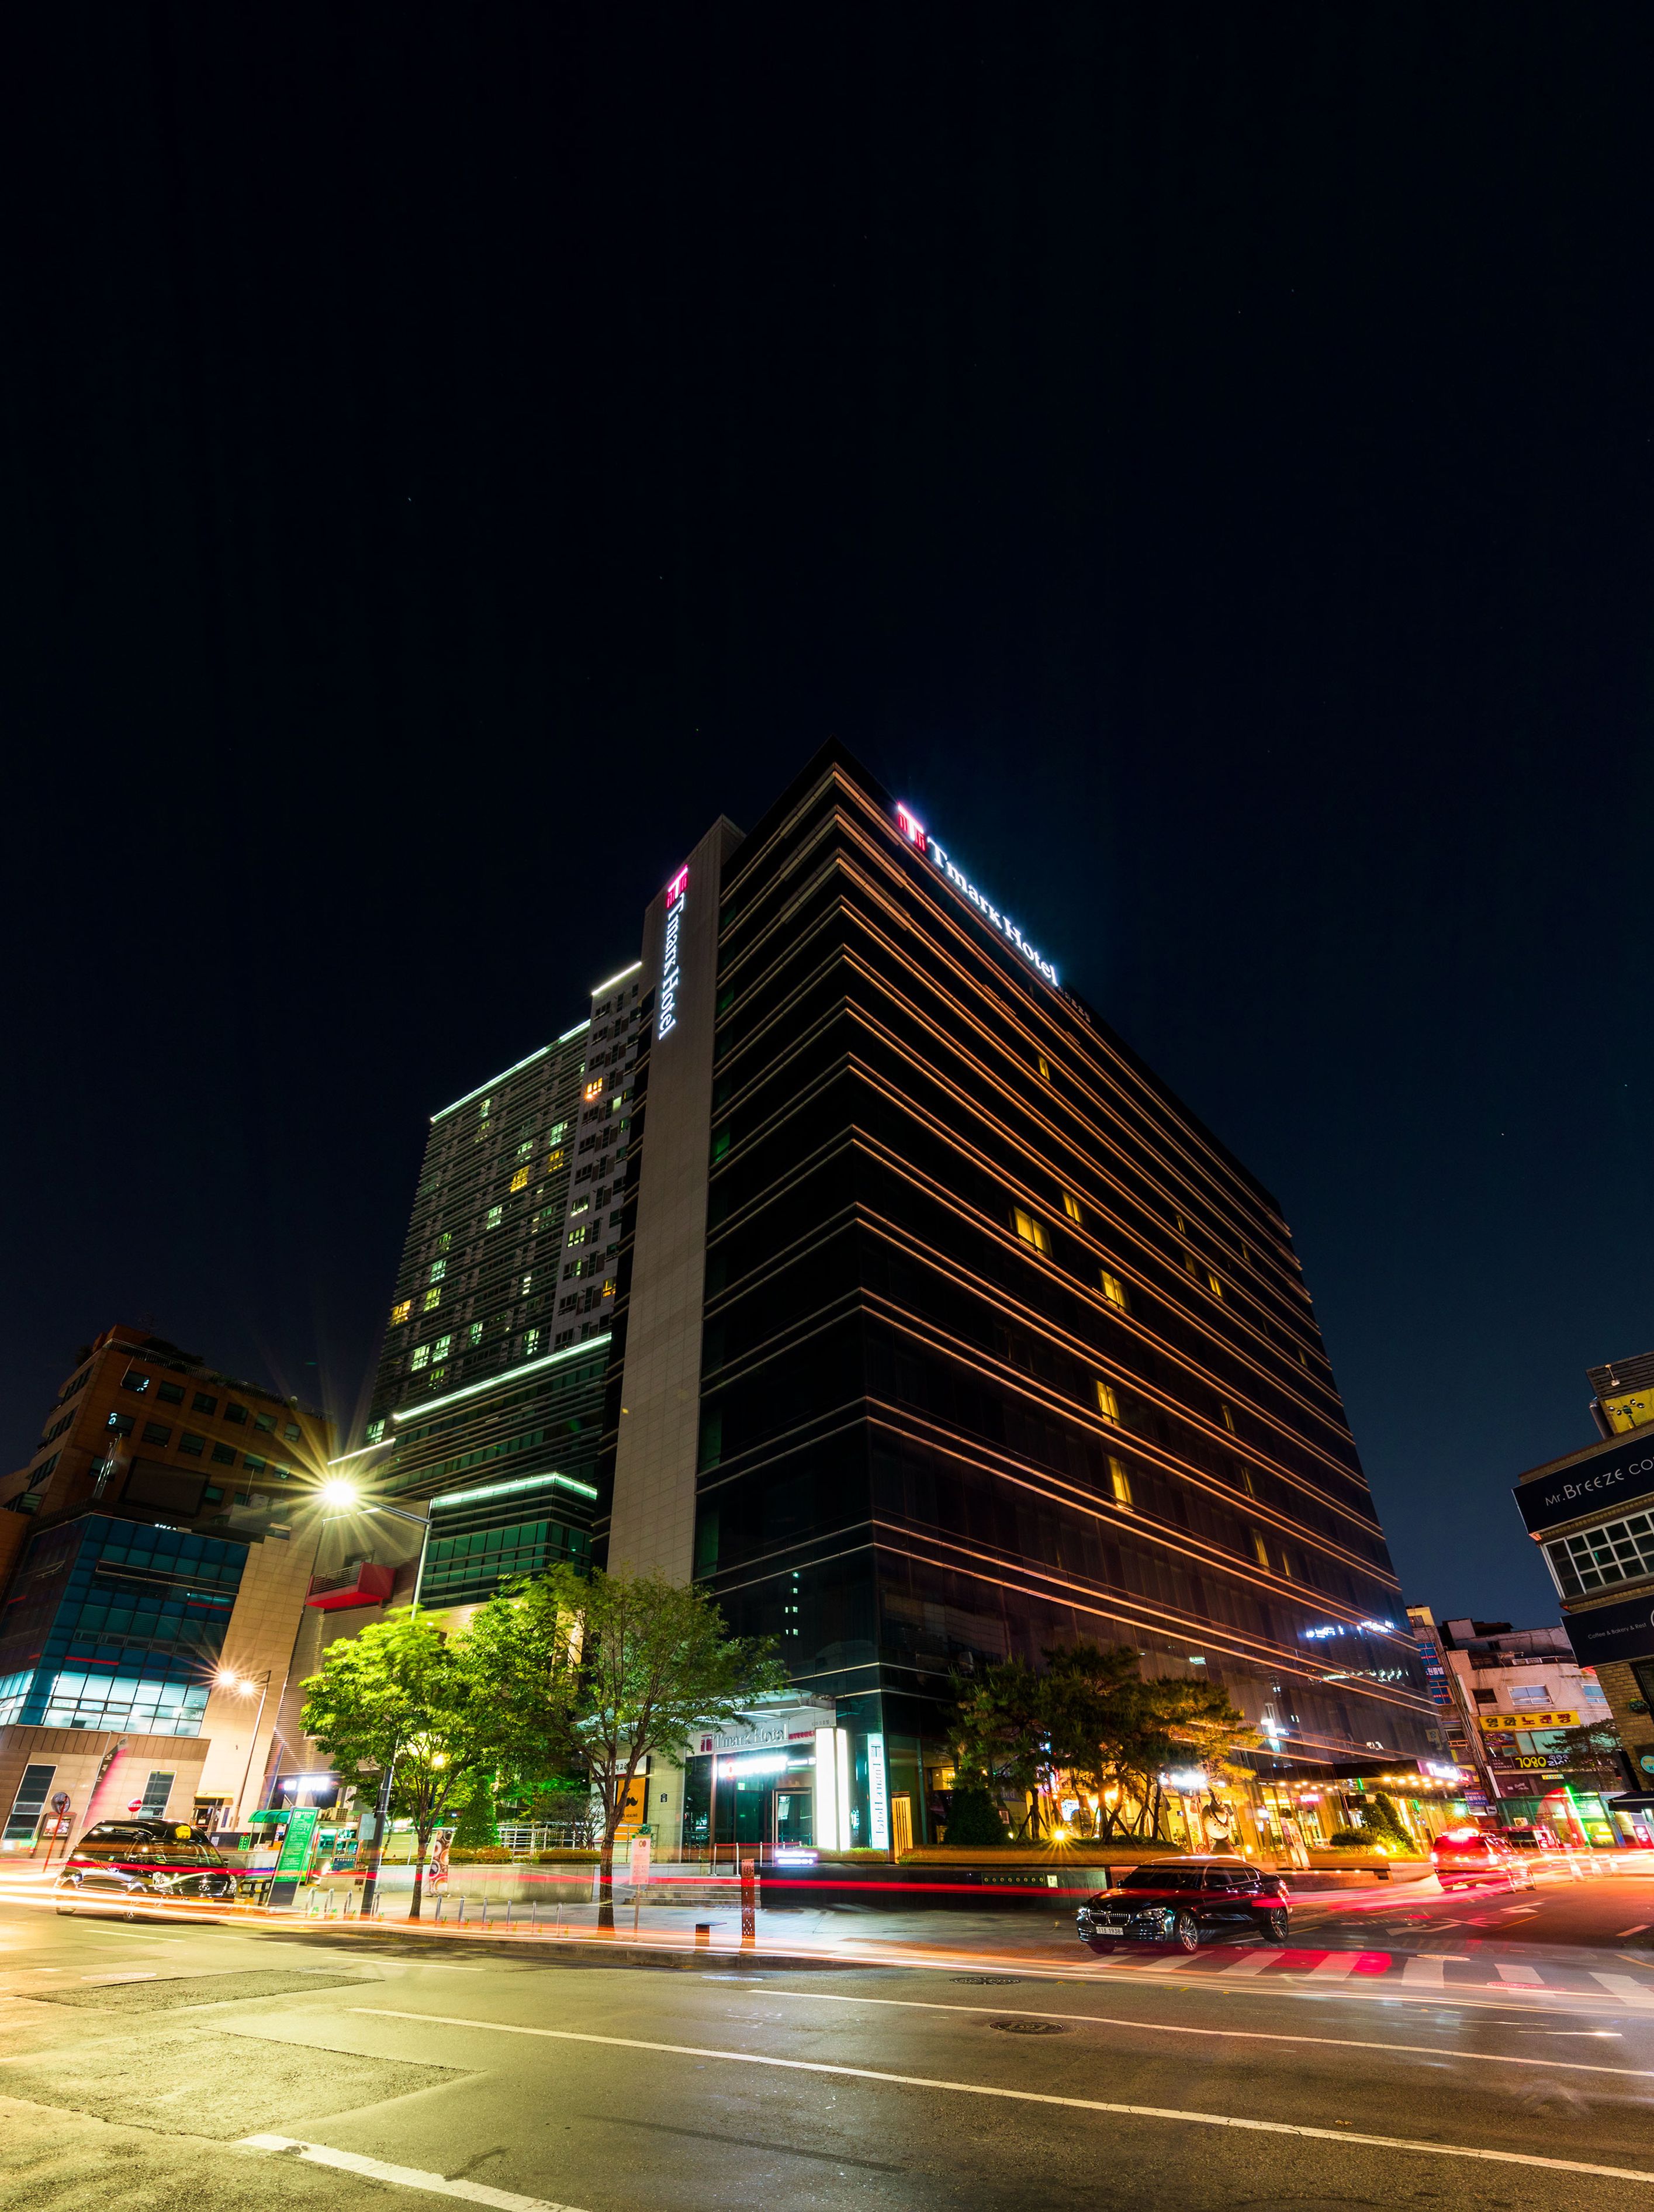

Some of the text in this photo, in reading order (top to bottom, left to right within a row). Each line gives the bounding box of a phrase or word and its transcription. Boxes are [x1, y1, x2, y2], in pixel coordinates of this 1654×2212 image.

[663, 892, 685, 976] Tmark
[927, 836, 1003, 928] Tmark
[1002, 916, 1059, 987] Hotel
[658, 965, 679, 1041] Hotel
[711, 1723, 788, 1749] Tmark Hotel
[1515, 1756, 1547, 1768] 7080
